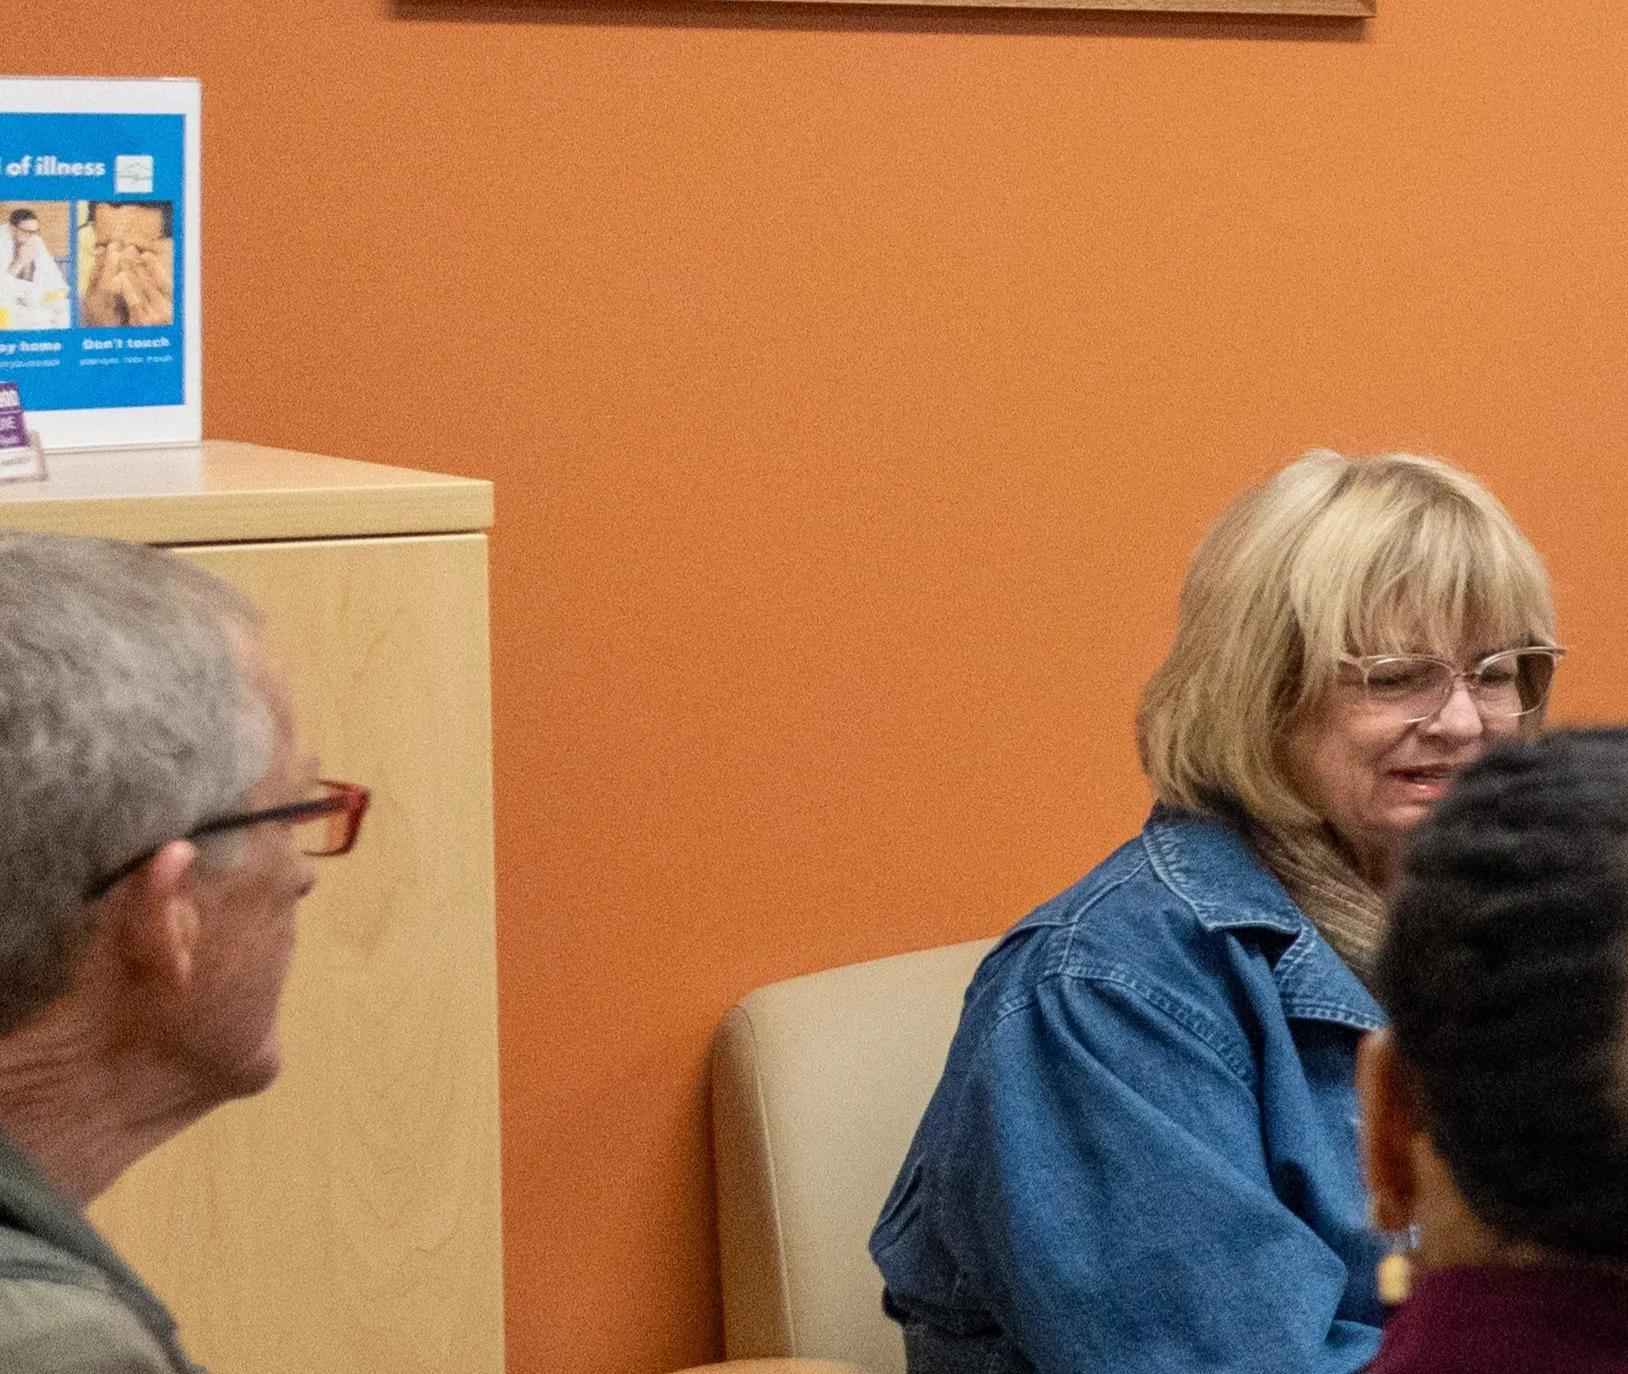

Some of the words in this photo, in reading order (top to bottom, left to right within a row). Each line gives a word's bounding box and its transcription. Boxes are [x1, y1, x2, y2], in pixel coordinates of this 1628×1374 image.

[5, 154, 33, 176] of
[35, 154, 106, 176] illness
[20, 341, 62, 352] home
[82, 338, 124, 350] Don't
[126, 337, 170, 349] touch
